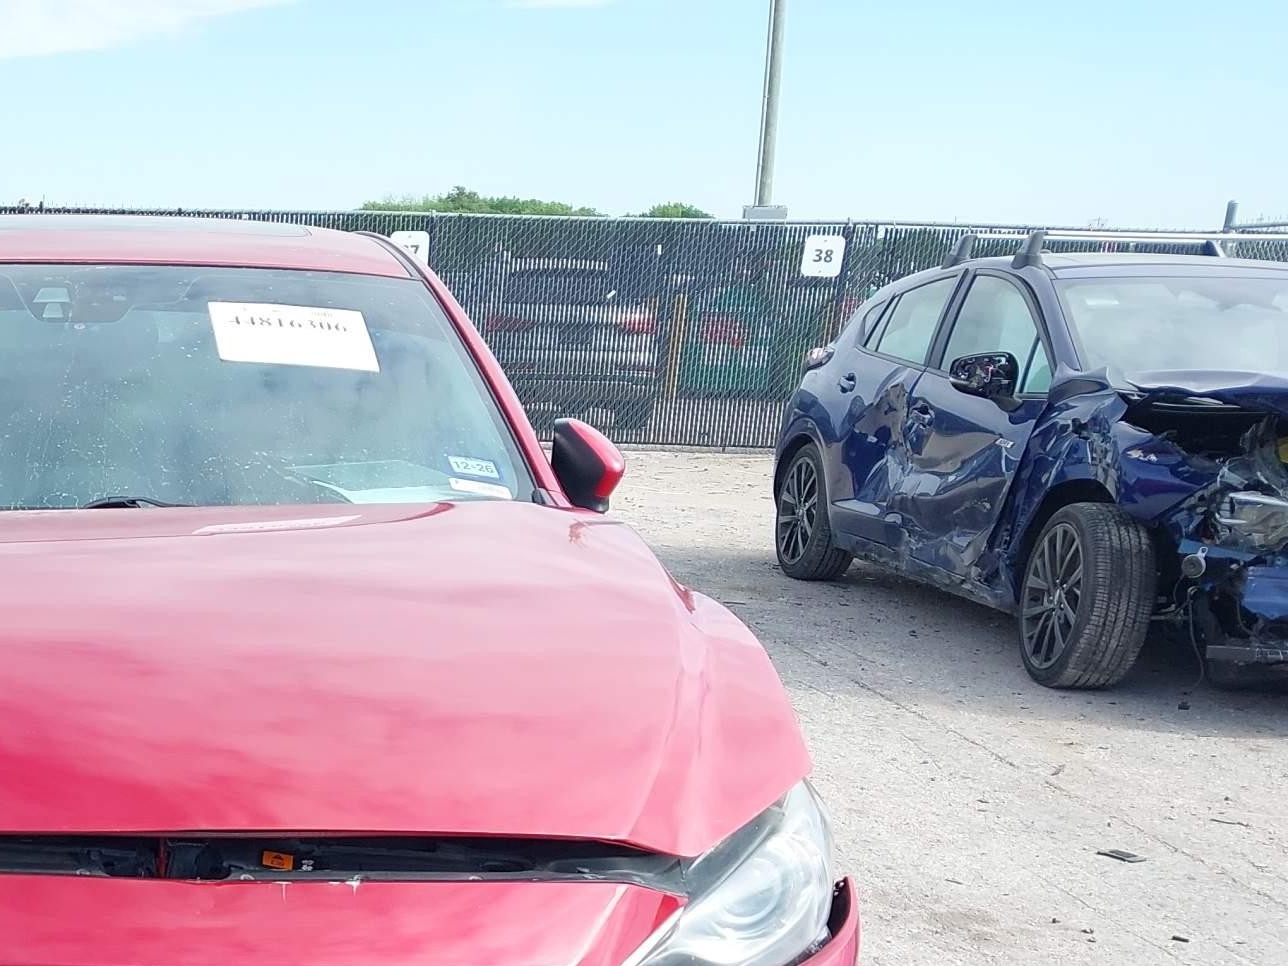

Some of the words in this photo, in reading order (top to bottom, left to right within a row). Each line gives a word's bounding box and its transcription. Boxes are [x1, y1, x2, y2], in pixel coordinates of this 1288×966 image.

[403, 244, 420, 255] 7
[812, 248, 834, 263] 38
[453, 461, 495, 474] 12-26
